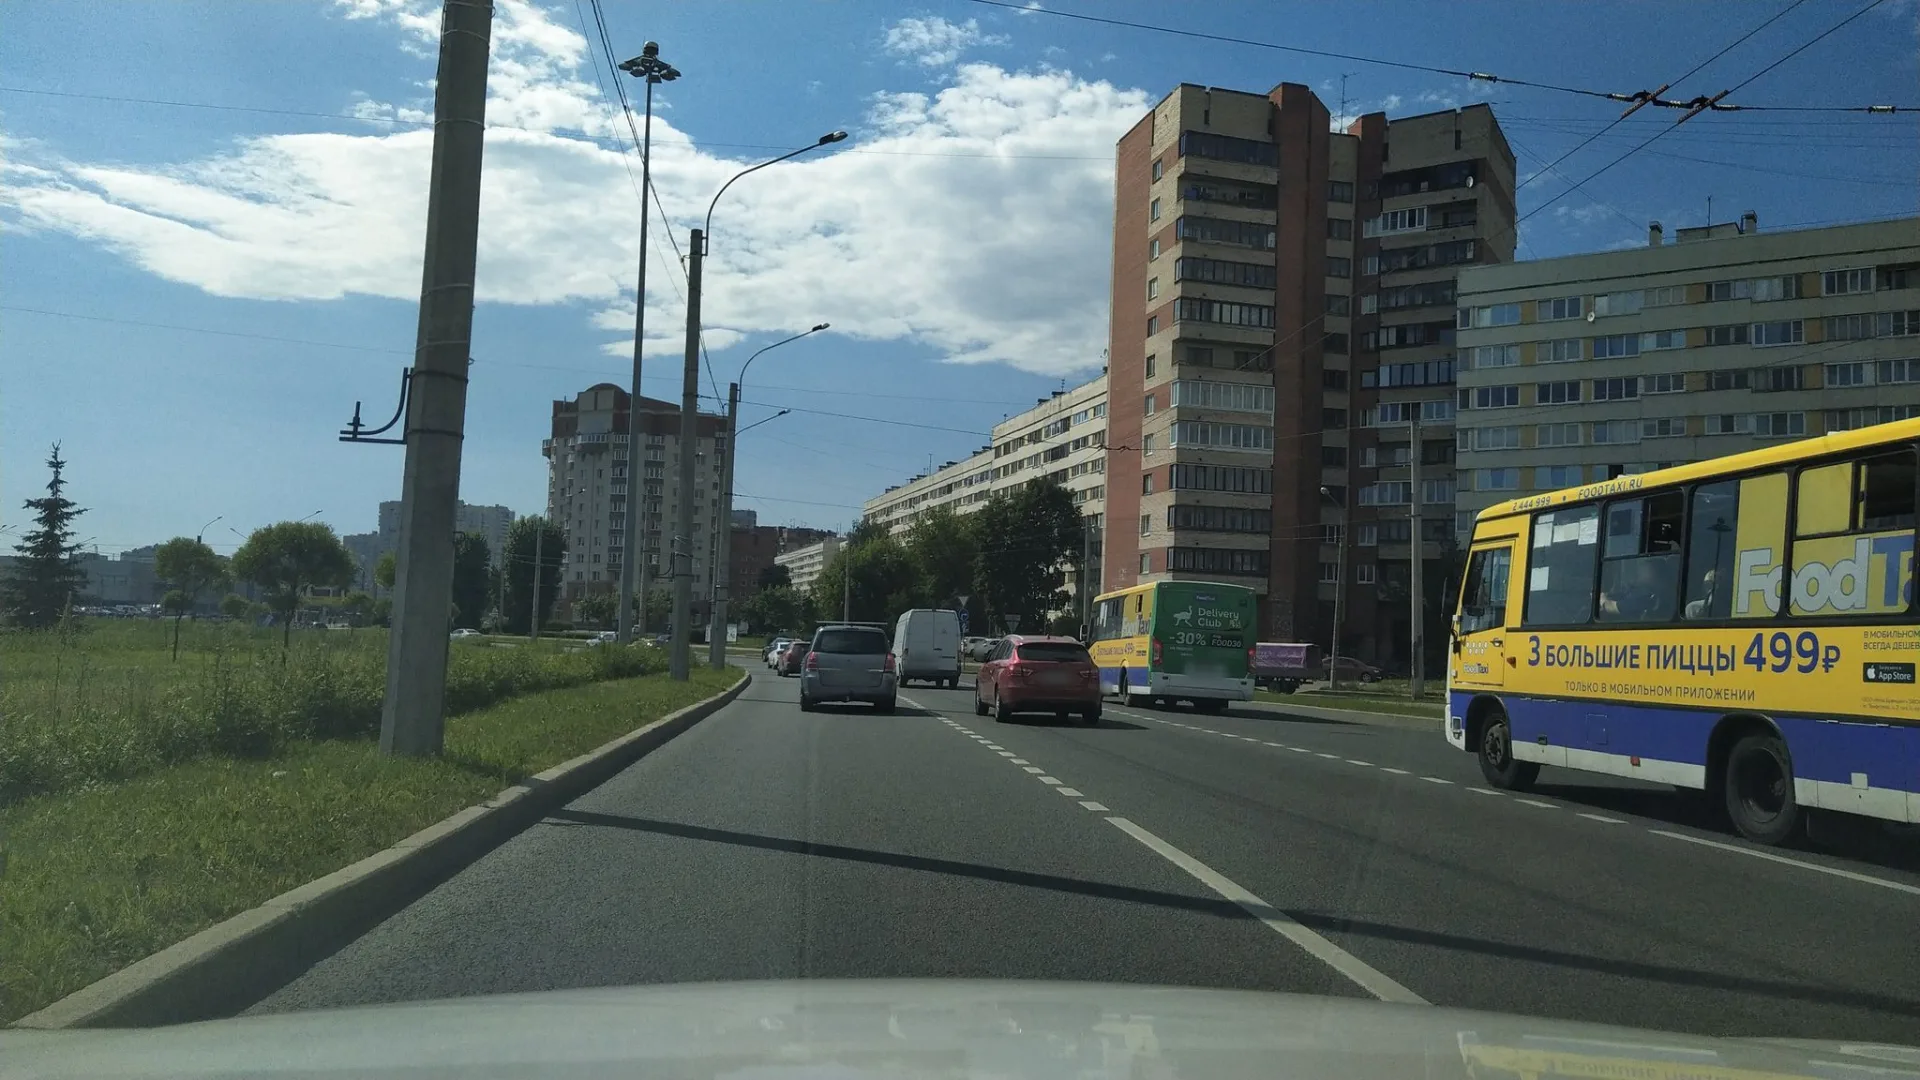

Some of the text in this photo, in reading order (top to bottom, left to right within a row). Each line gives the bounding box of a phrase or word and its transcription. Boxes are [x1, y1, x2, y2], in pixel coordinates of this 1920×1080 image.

[1519, 499, 1533, 510] 444
[1535, 495, 1551, 507] 999
[1577, 477, 1643, 499] FOODTAXI.RU
[1736, 534, 1914, 613] FoodT
[1198, 607, 1240, 621] Delivery
[1197, 617, 1222, 628] Club
[1211, 639, 1242, 648] FOOD30
[1863, 641, 1891, 651] ВСЕГДА
[1528, 635, 1541, 667] 3
[1545, 644, 1640, 670] БОЛЬШИЕ
[1646, 644, 1736, 676] ПИЦЦЫ
[1878, 671, 1912, 682] App Store
[1565, 680, 1756, 702] ТОЛЬКО В МОБИЛЬНОМ ПРИЛОЖЕНИИ
